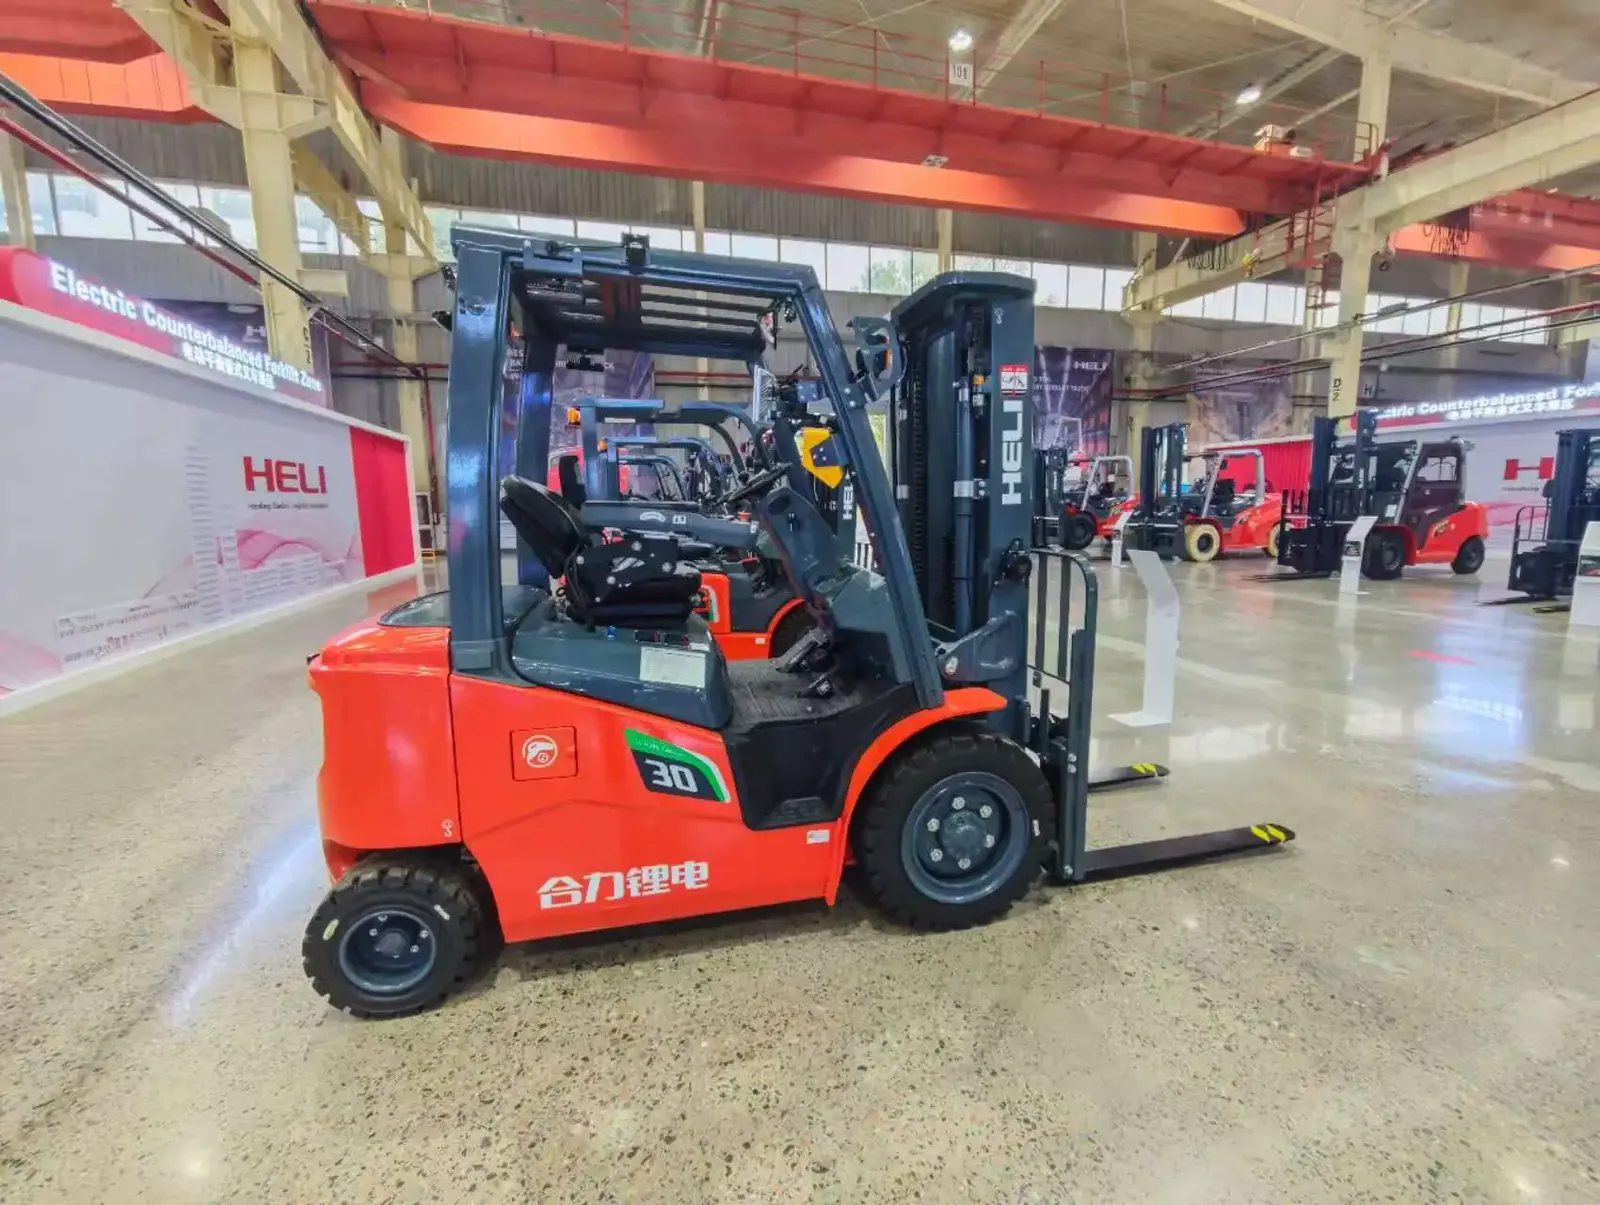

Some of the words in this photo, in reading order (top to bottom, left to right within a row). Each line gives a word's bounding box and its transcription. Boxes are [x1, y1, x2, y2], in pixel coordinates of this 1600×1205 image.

[50, 260, 138, 320] Electric
[142, 301, 262, 370] Counterbalanced
[1418, 388, 1557, 414] Counterbalanced
[1001, 399, 1023, 505] HELI
[243, 455, 328, 494] HELI
[644, 758, 698, 793] 30
[536, 860, 709, 910] 合力锂电
